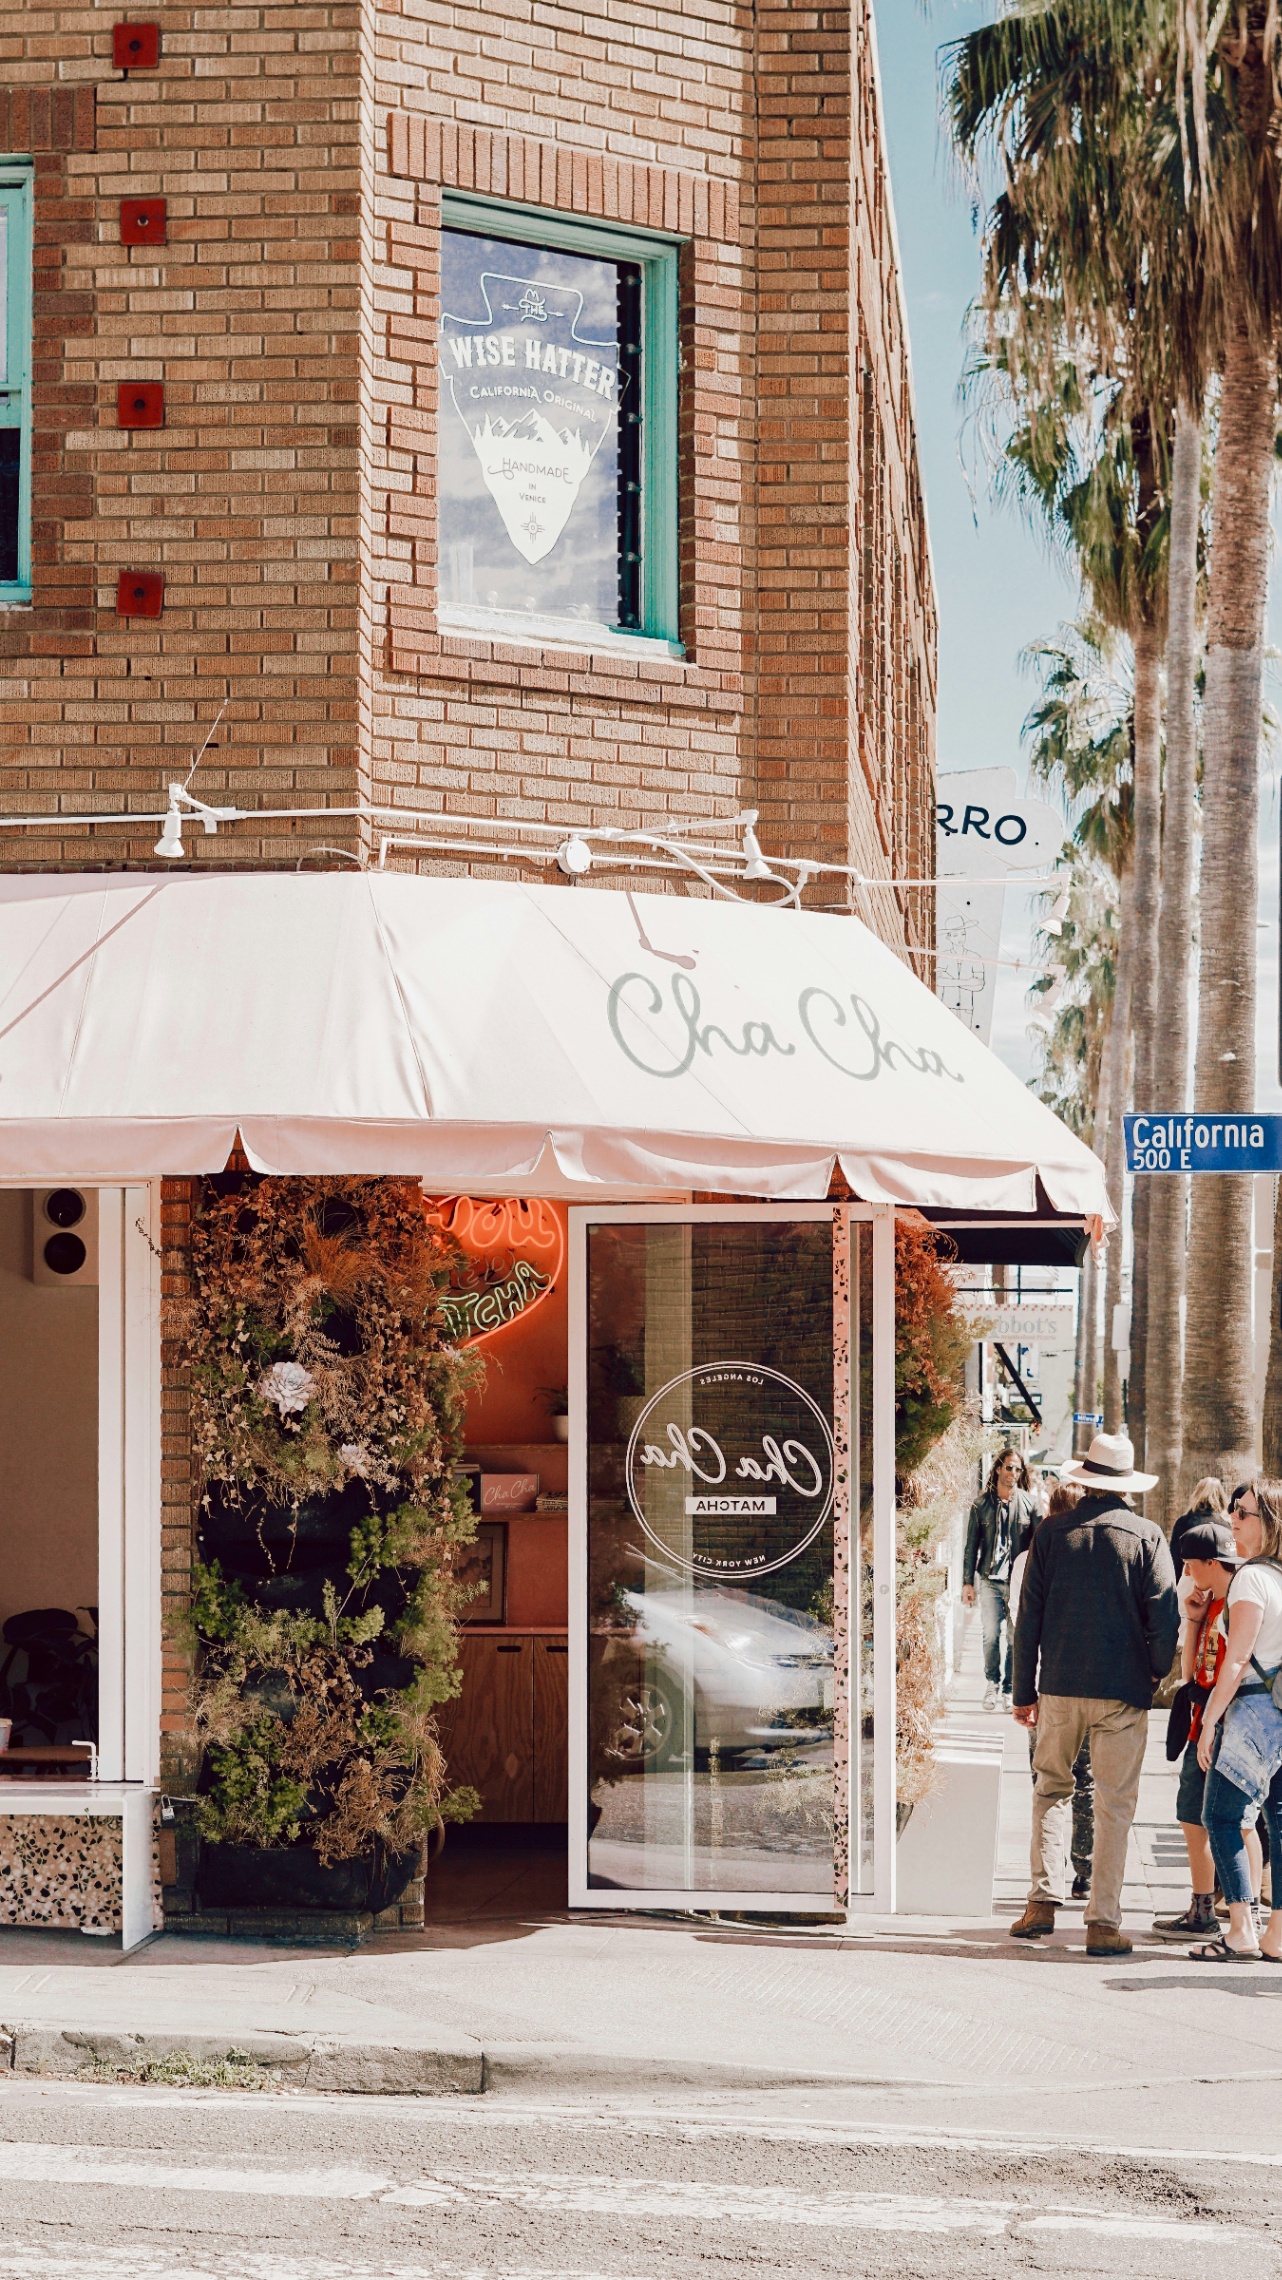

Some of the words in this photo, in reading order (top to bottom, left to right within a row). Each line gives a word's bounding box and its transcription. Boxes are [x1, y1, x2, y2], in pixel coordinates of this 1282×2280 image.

[519, 301, 547, 318] THE
[448, 335, 516, 370] WISE
[524, 339, 617, 401] HATTER
[607, 972, 796, 1079] Cha
[798, 986, 965, 1084] Cha
[1133, 1118, 1265, 1148] California
[1133, 1149, 1171, 1170] 500
[1180, 1149, 1192, 1169] E
